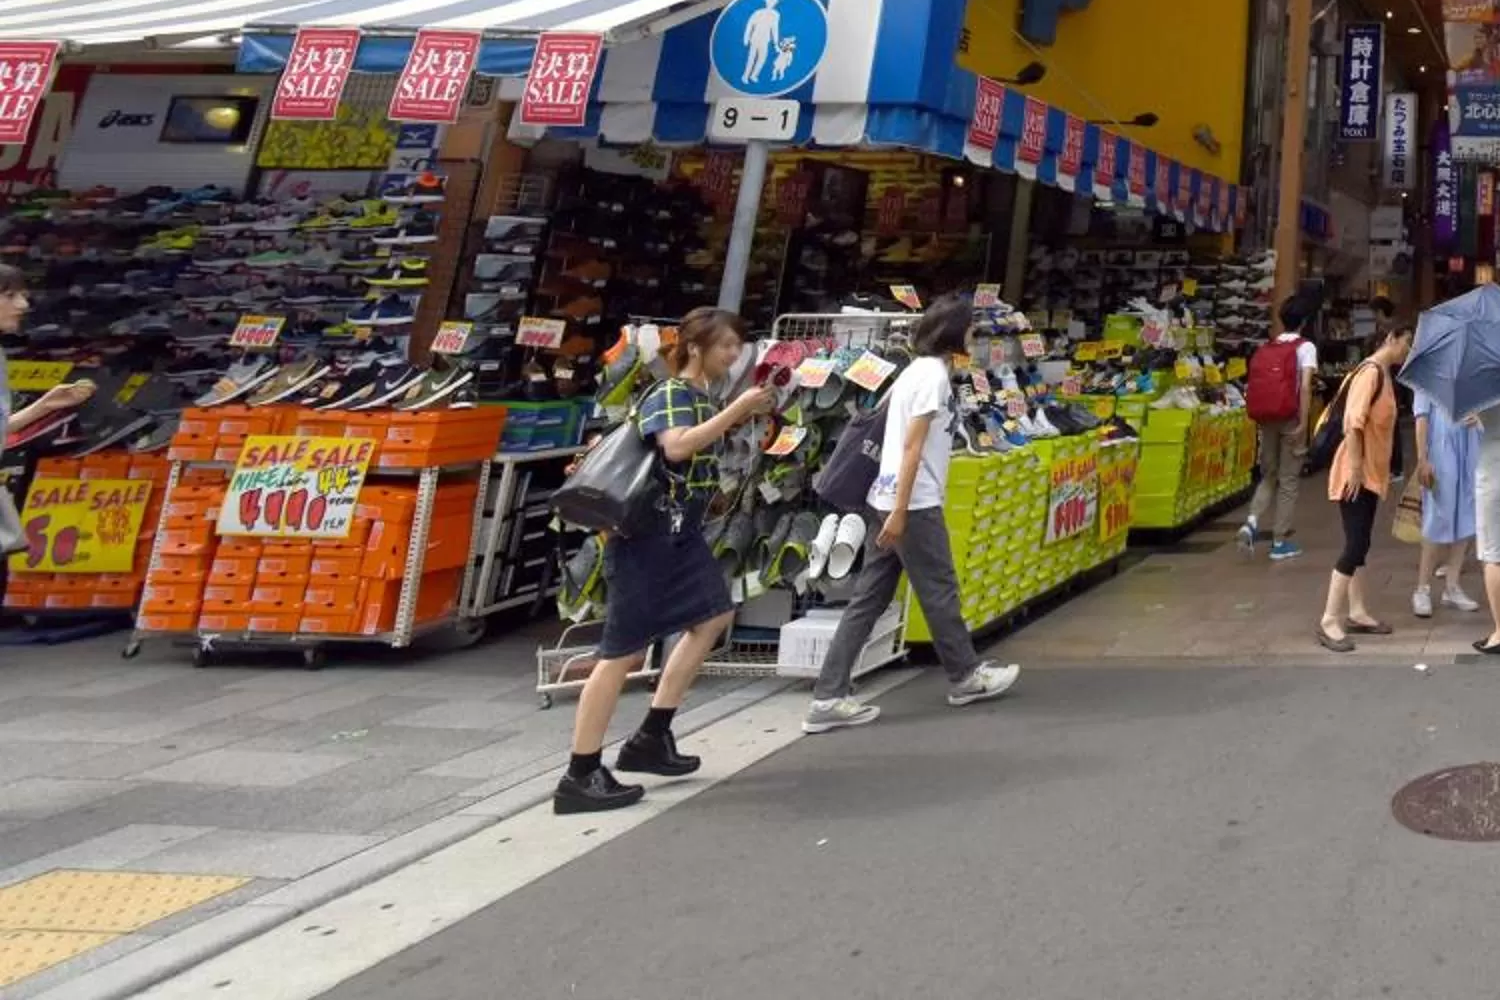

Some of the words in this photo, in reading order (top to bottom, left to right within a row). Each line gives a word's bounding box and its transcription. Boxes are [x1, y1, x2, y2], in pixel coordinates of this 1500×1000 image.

[292, 47, 352, 74] 決算
[410, 49, 470, 77] 決算
[535, 52, 593, 80] 決算
[281, 75, 342, 98] SALE
[400, 77, 461, 101] SALE
[527, 80, 586, 104] SALE
[1347, 36, 1374, 125] 時計倉庫
[0, 95, 34, 120] LE
[243, 440, 310, 467] SALE
[308, 442, 370, 470] SALE
[29, 483, 88, 509] SALE
[89, 484, 147, 511] SALE
